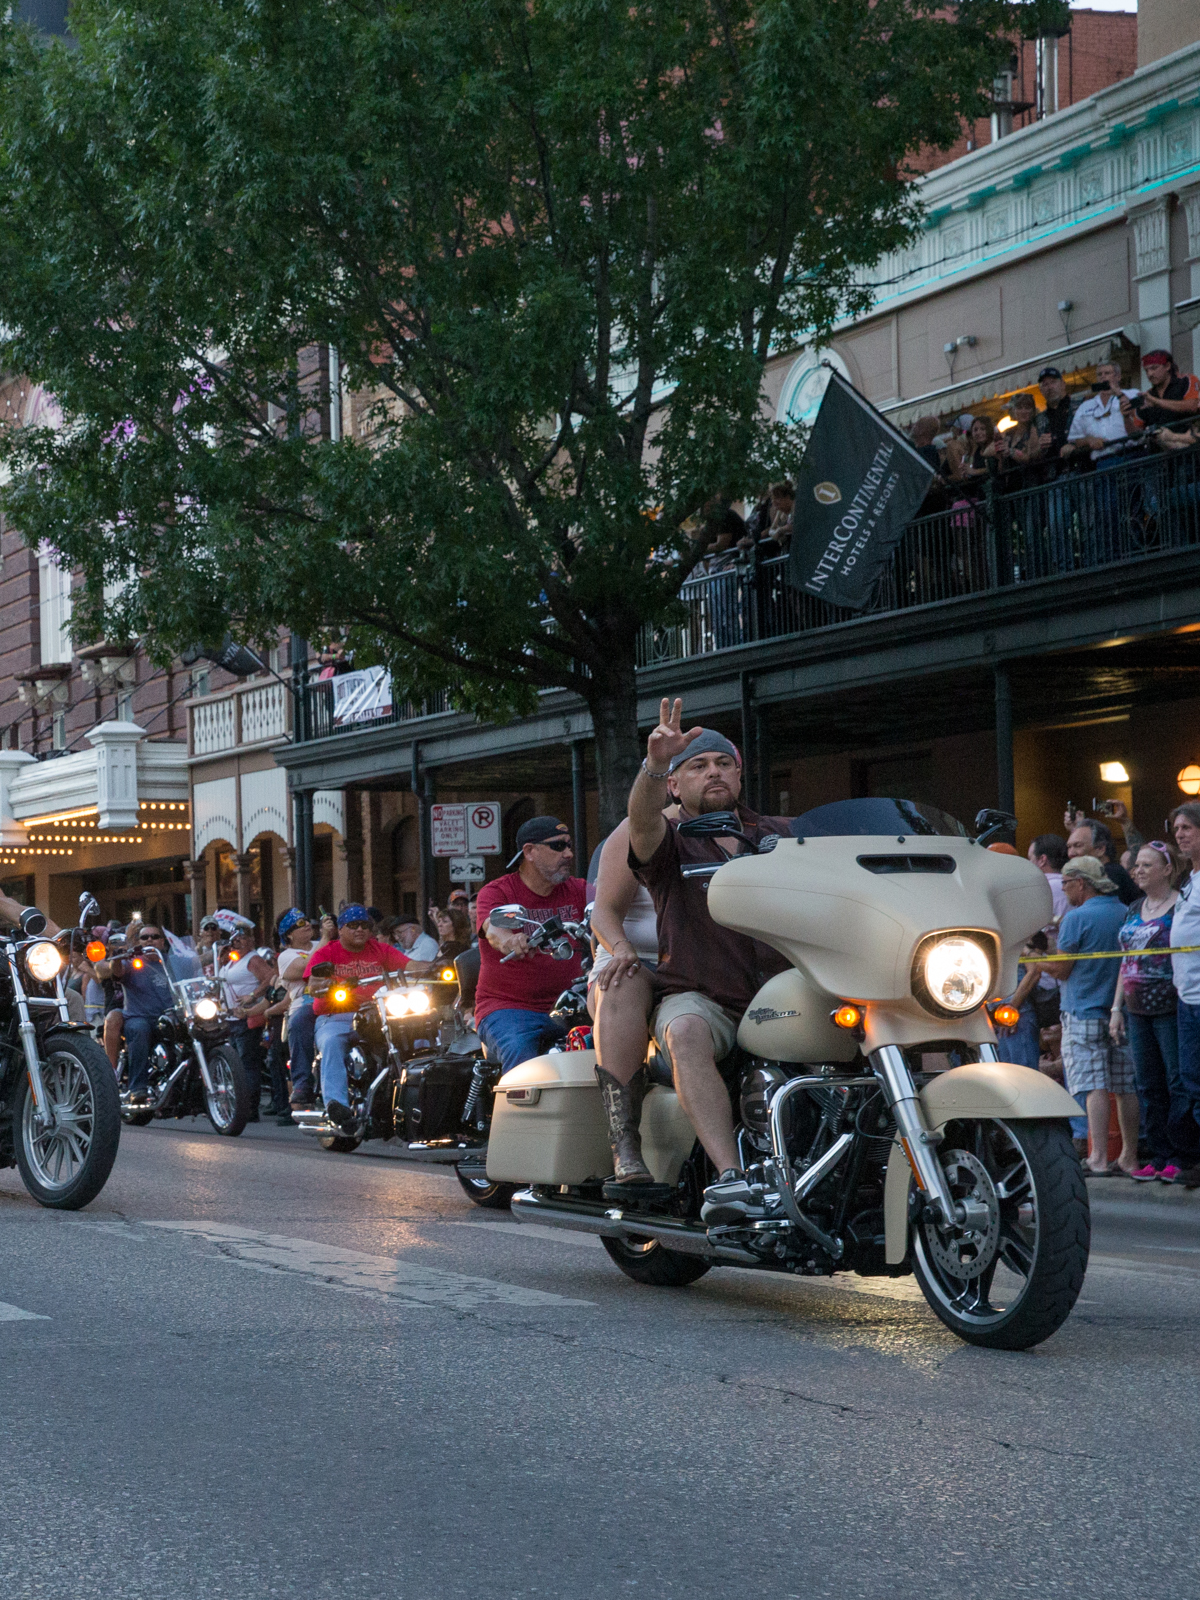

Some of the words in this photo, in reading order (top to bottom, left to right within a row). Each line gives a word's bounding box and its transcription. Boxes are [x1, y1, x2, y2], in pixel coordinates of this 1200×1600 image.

[805, 442, 895, 592] INTERCONTINENTAL
[840, 529, 871, 576] HOTELS
[873, 472, 899, 516] RESORTS
